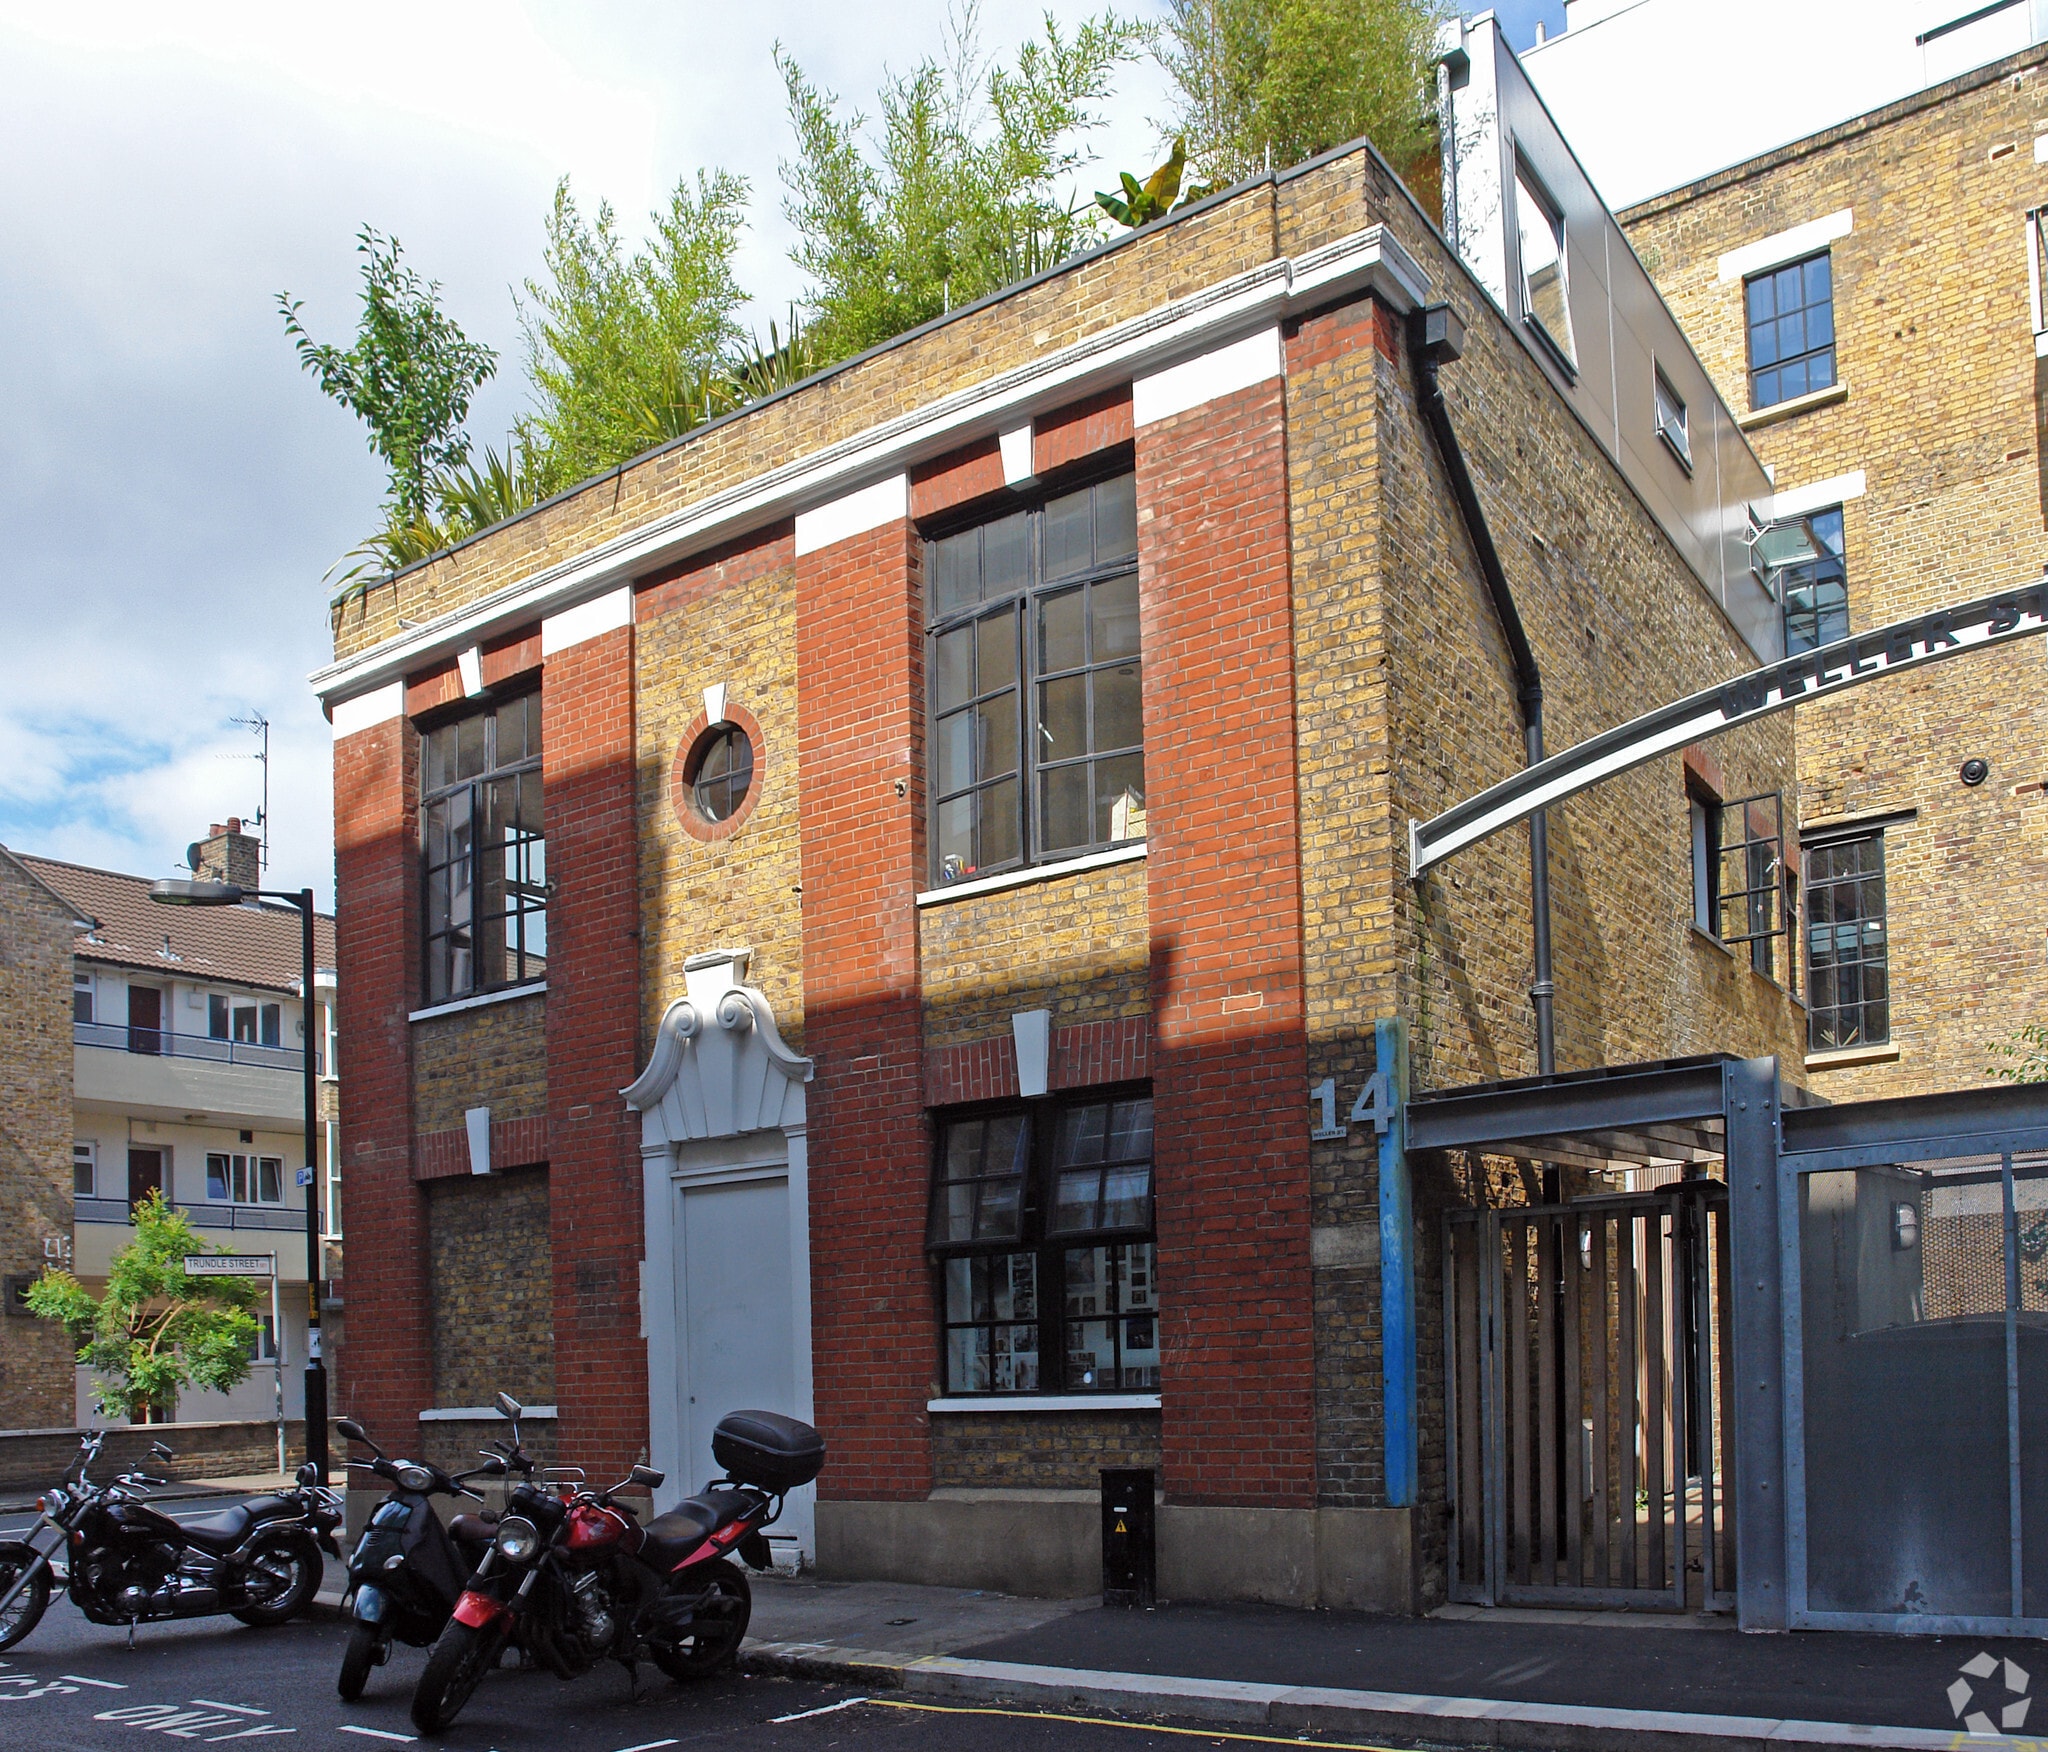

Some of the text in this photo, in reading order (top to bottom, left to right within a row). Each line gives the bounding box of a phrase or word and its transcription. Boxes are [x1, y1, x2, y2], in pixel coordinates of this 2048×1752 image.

[1719, 612, 1960, 720] WELLER
[1311, 1072, 1396, 1140] 14
[188, 1258, 227, 1269] TRUNDLE
[228, 1258, 259, 1269] STREET
[93, 1704, 297, 1742] ONLY
